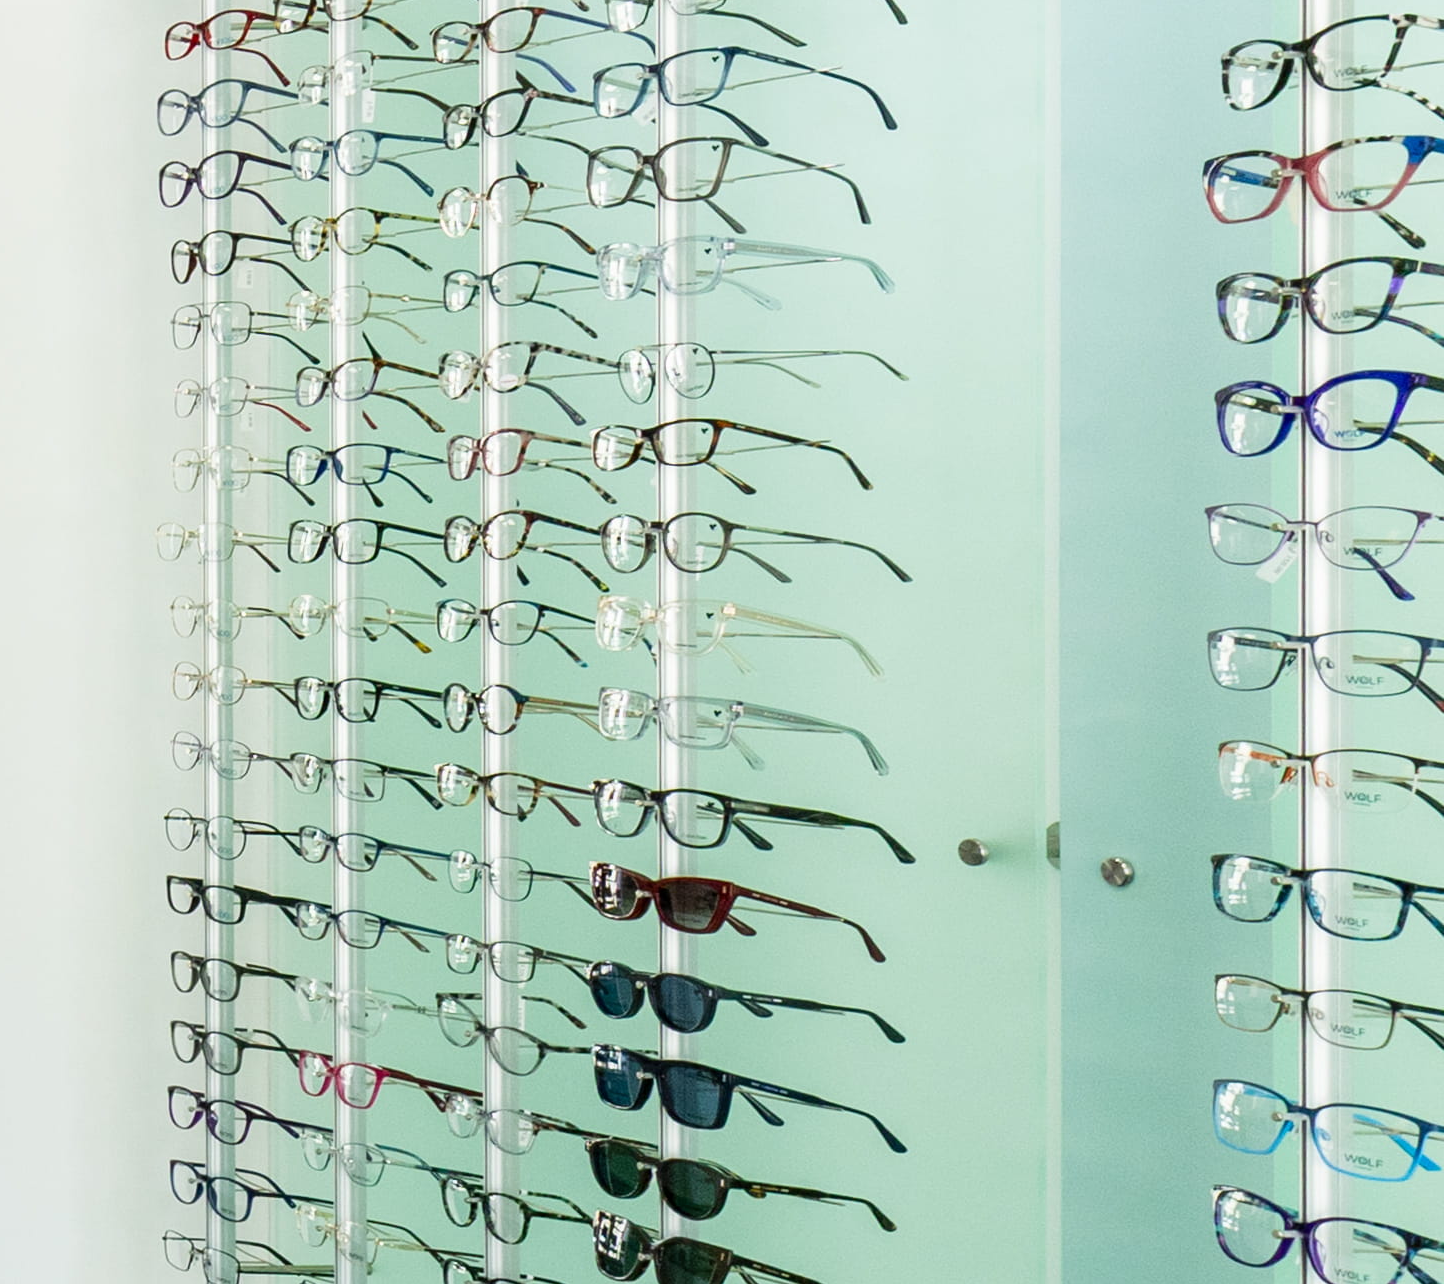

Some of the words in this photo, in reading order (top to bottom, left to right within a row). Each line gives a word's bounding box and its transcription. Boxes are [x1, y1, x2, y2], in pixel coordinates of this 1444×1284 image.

[1345, 675, 1384, 686] WOLF
[1344, 791, 1382, 803] WOLF
[1335, 915, 1369, 927] WOLF
[1344, 1152, 1384, 1168] WOLF
